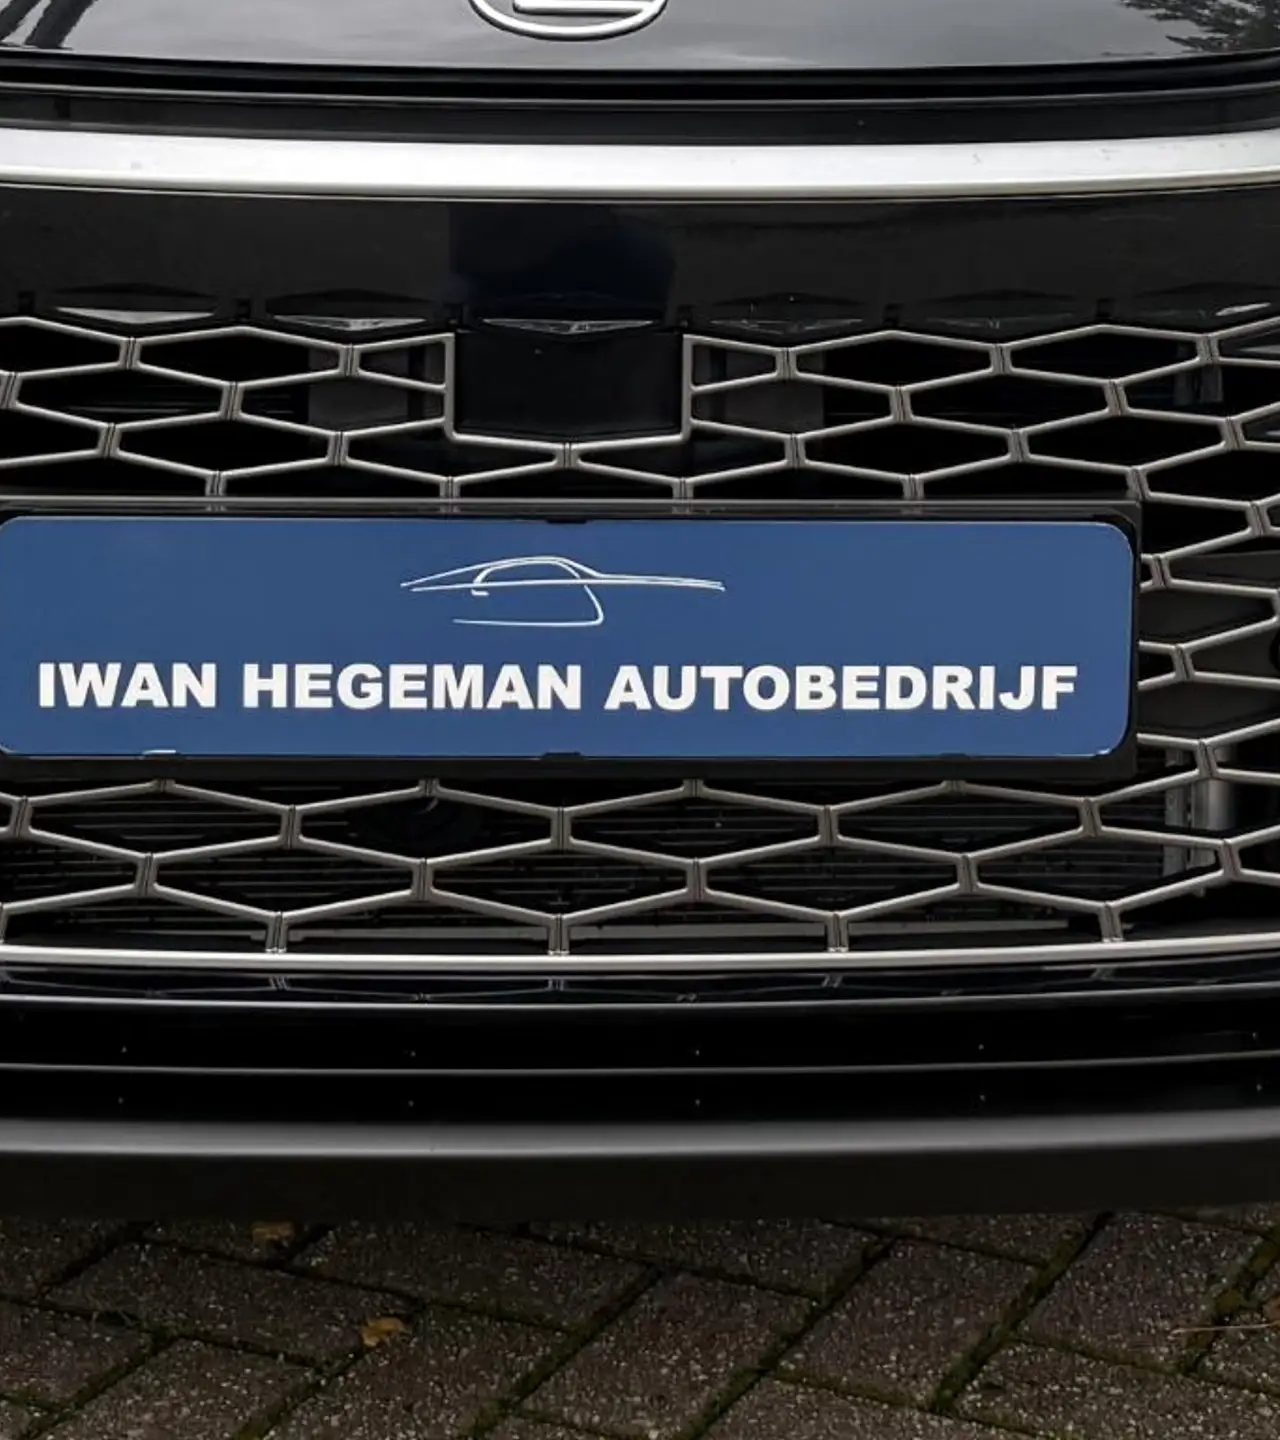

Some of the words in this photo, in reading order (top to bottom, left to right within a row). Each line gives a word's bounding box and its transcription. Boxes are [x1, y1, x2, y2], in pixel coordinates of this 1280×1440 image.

[39, 663, 216, 708] IWAN
[243, 663, 581, 710] HEGEMAN
[604, 665, 1078, 711] AUTOBEDRIJF
